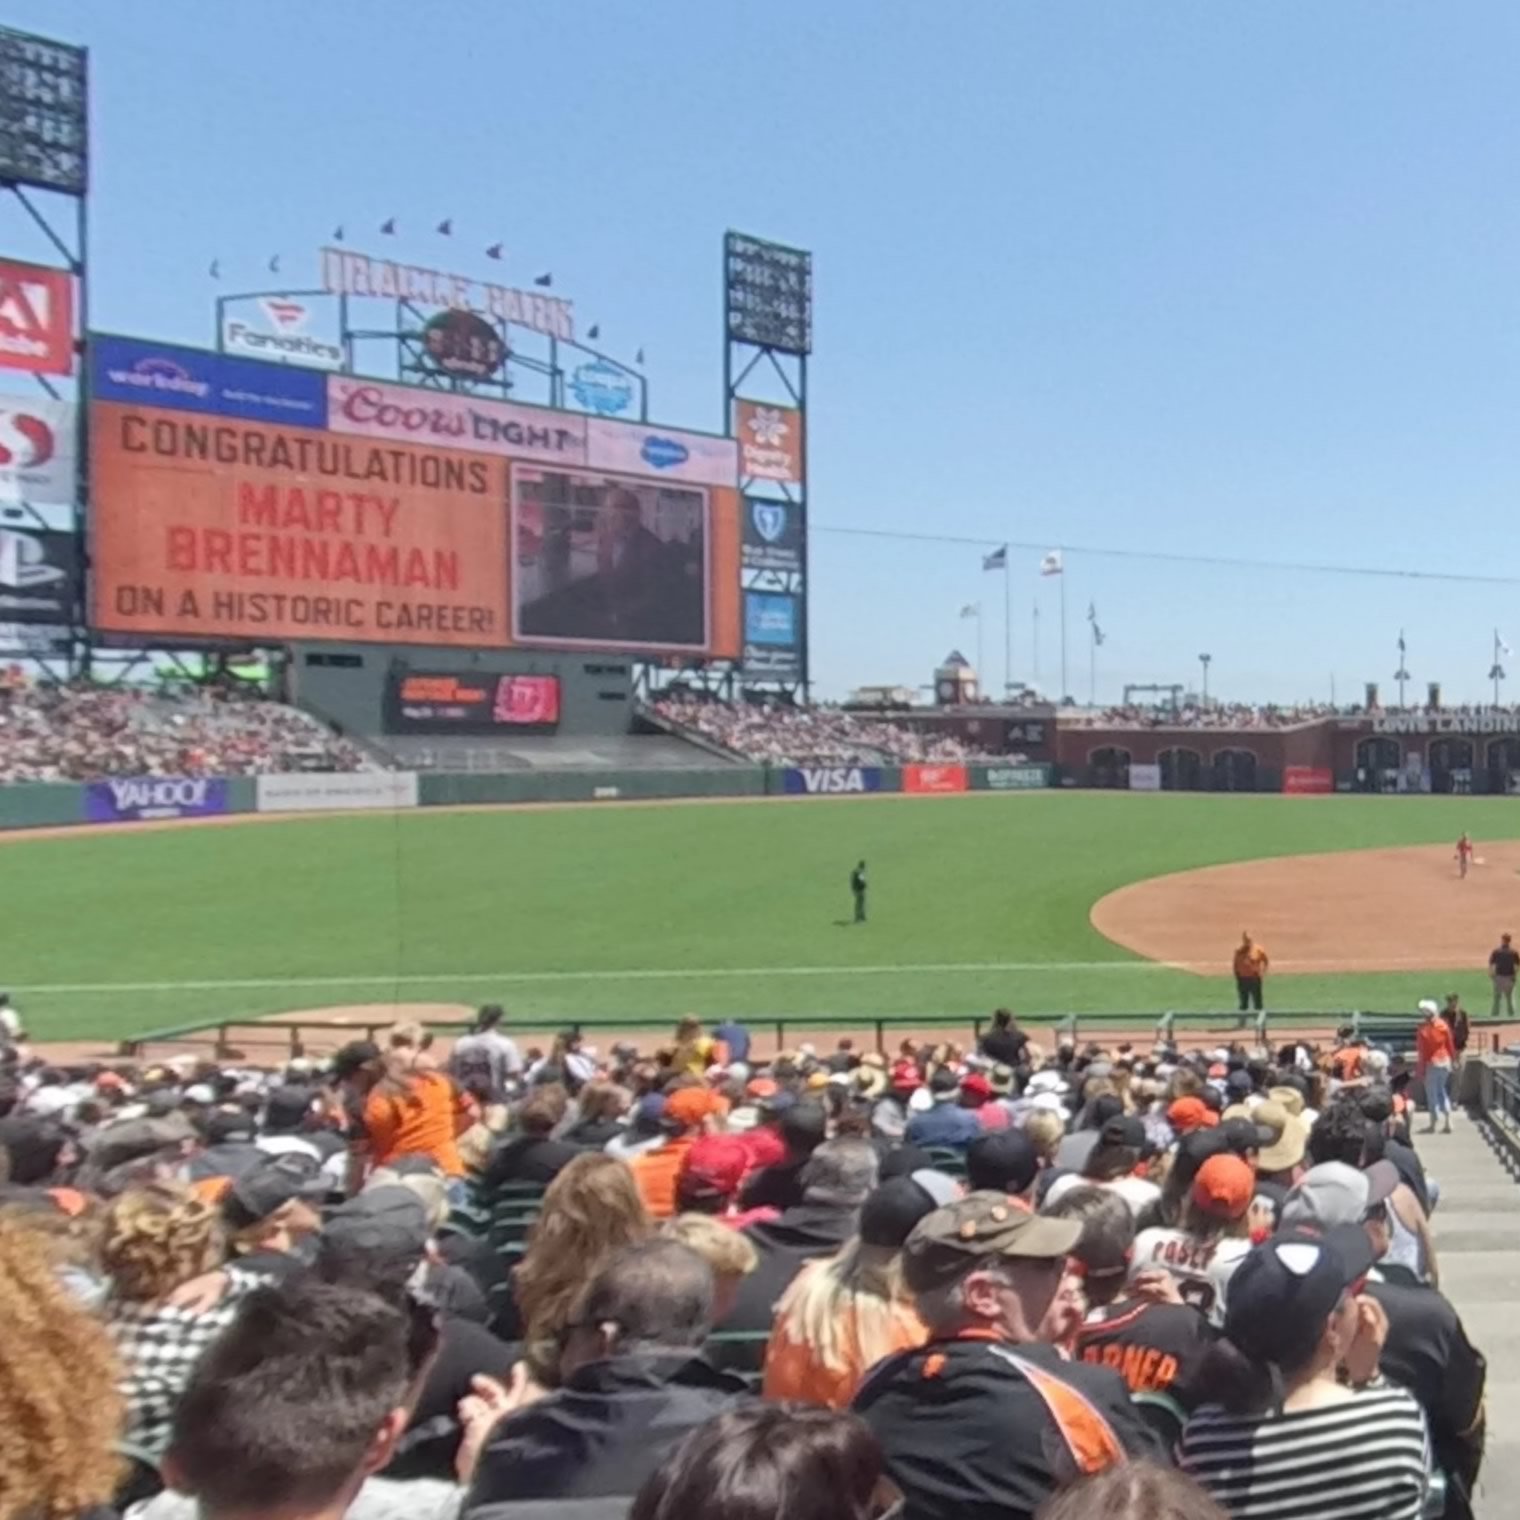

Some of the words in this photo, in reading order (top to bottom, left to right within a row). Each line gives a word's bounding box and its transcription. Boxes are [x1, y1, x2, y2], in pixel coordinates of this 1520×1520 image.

[320, 247, 468, 307] ORACLE
[487, 286, 574, 341] PARK
[229, 322, 341, 361] Fanatics
[341, 384, 466, 437] Coors
[469, 408, 570, 450] LIGHT
[121, 414, 489, 494] CONGRATULATIONS
[237, 481, 401, 537] MARTY
[166, 526, 460, 591] BRENNAMAN
[116, 585, 164, 617] ON
[177, 588, 201, 618] A
[213, 591, 365, 629] HISTORIC
[376, 600, 495, 634] CAREER!
[801, 768, 865, 792] VISA
